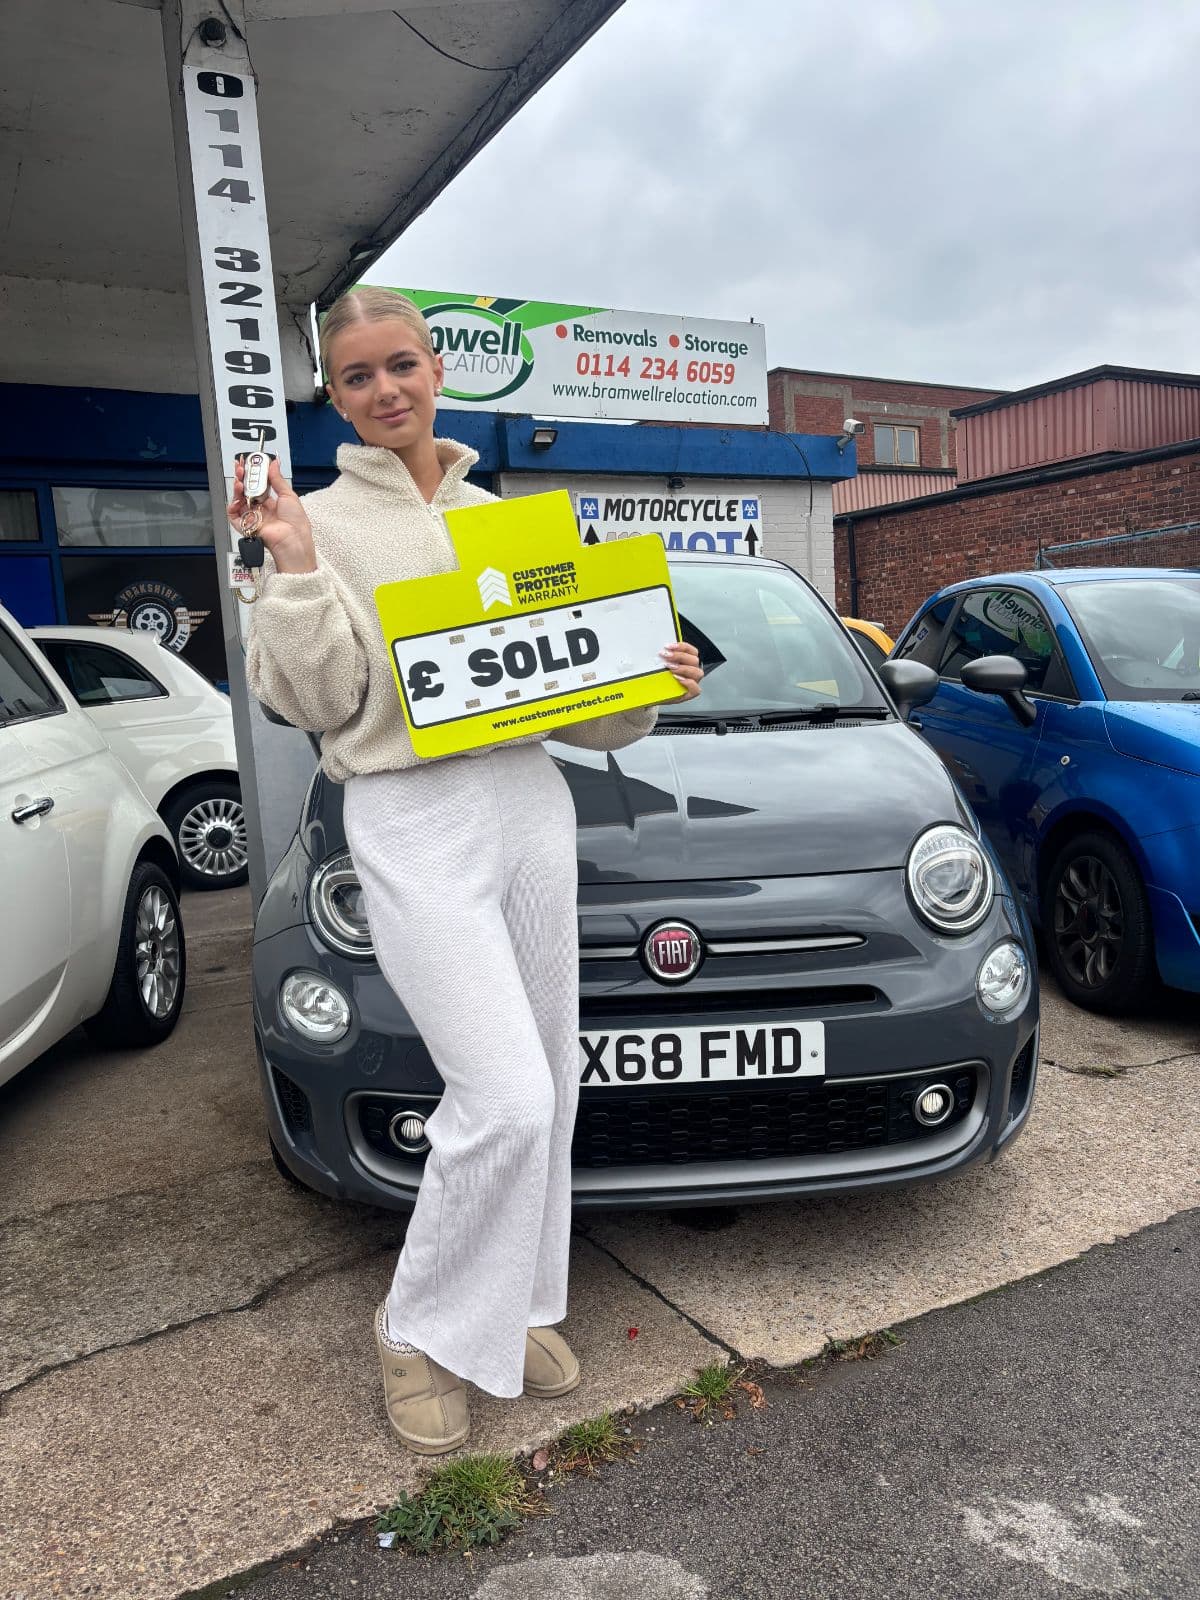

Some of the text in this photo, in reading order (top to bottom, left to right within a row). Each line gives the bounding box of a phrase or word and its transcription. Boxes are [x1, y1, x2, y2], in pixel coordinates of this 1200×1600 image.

[197, 71, 277, 461] 0114 321965
[573, 323, 749, 358] Removals Storage
[443, 352, 515, 376] CATION
[576, 352, 736, 385] 0114 234 6059
[552, 382, 758, 408] www.bramwellrelocation.com
[603, 498, 739, 522] MOTORCYCLE
[512, 561, 575, 582] CUSTOMER
[515, 572, 577, 594] PROTECT
[119, 583, 179, 602] YORKSHIRE
[518, 584, 579, 605] WARRANTY
[407, 627, 600, 702] £ SOLD
[491, 690, 625, 731] www.customerprotect.com
[657, 939, 690, 966] FIAT
[579, 1027, 802, 1083] X68 FMD
